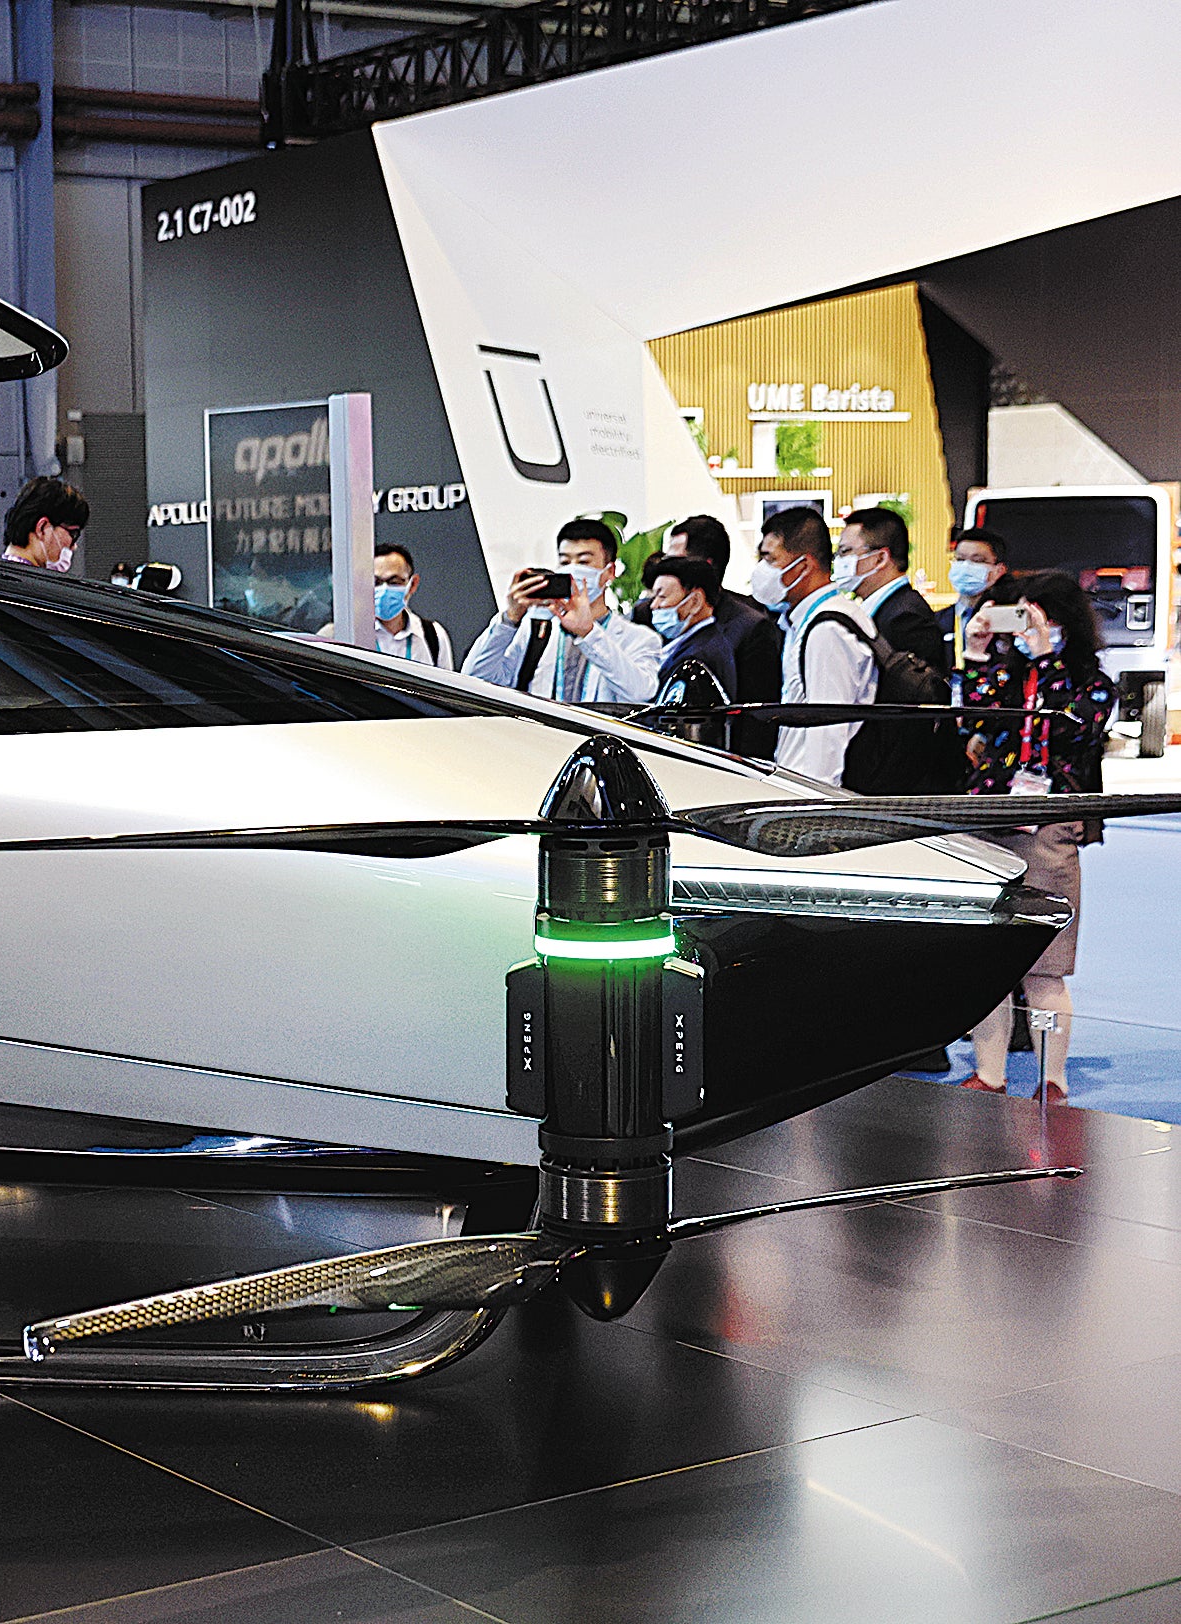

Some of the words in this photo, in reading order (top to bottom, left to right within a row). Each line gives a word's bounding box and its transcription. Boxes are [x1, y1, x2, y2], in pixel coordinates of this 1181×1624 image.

[158, 207, 183, 242] 2.1
[189, 190, 256, 234] C7-002
[747, 382, 805, 411] UME
[811, 382, 895, 412] Barista
[234, 417, 331, 486] apoll
[148, 500, 209, 527] APOLLO
[388, 482, 466, 513] GROUP
[523, 1012, 532, 1071] XPENG
[675, 1014, 684, 1073] XPENG
